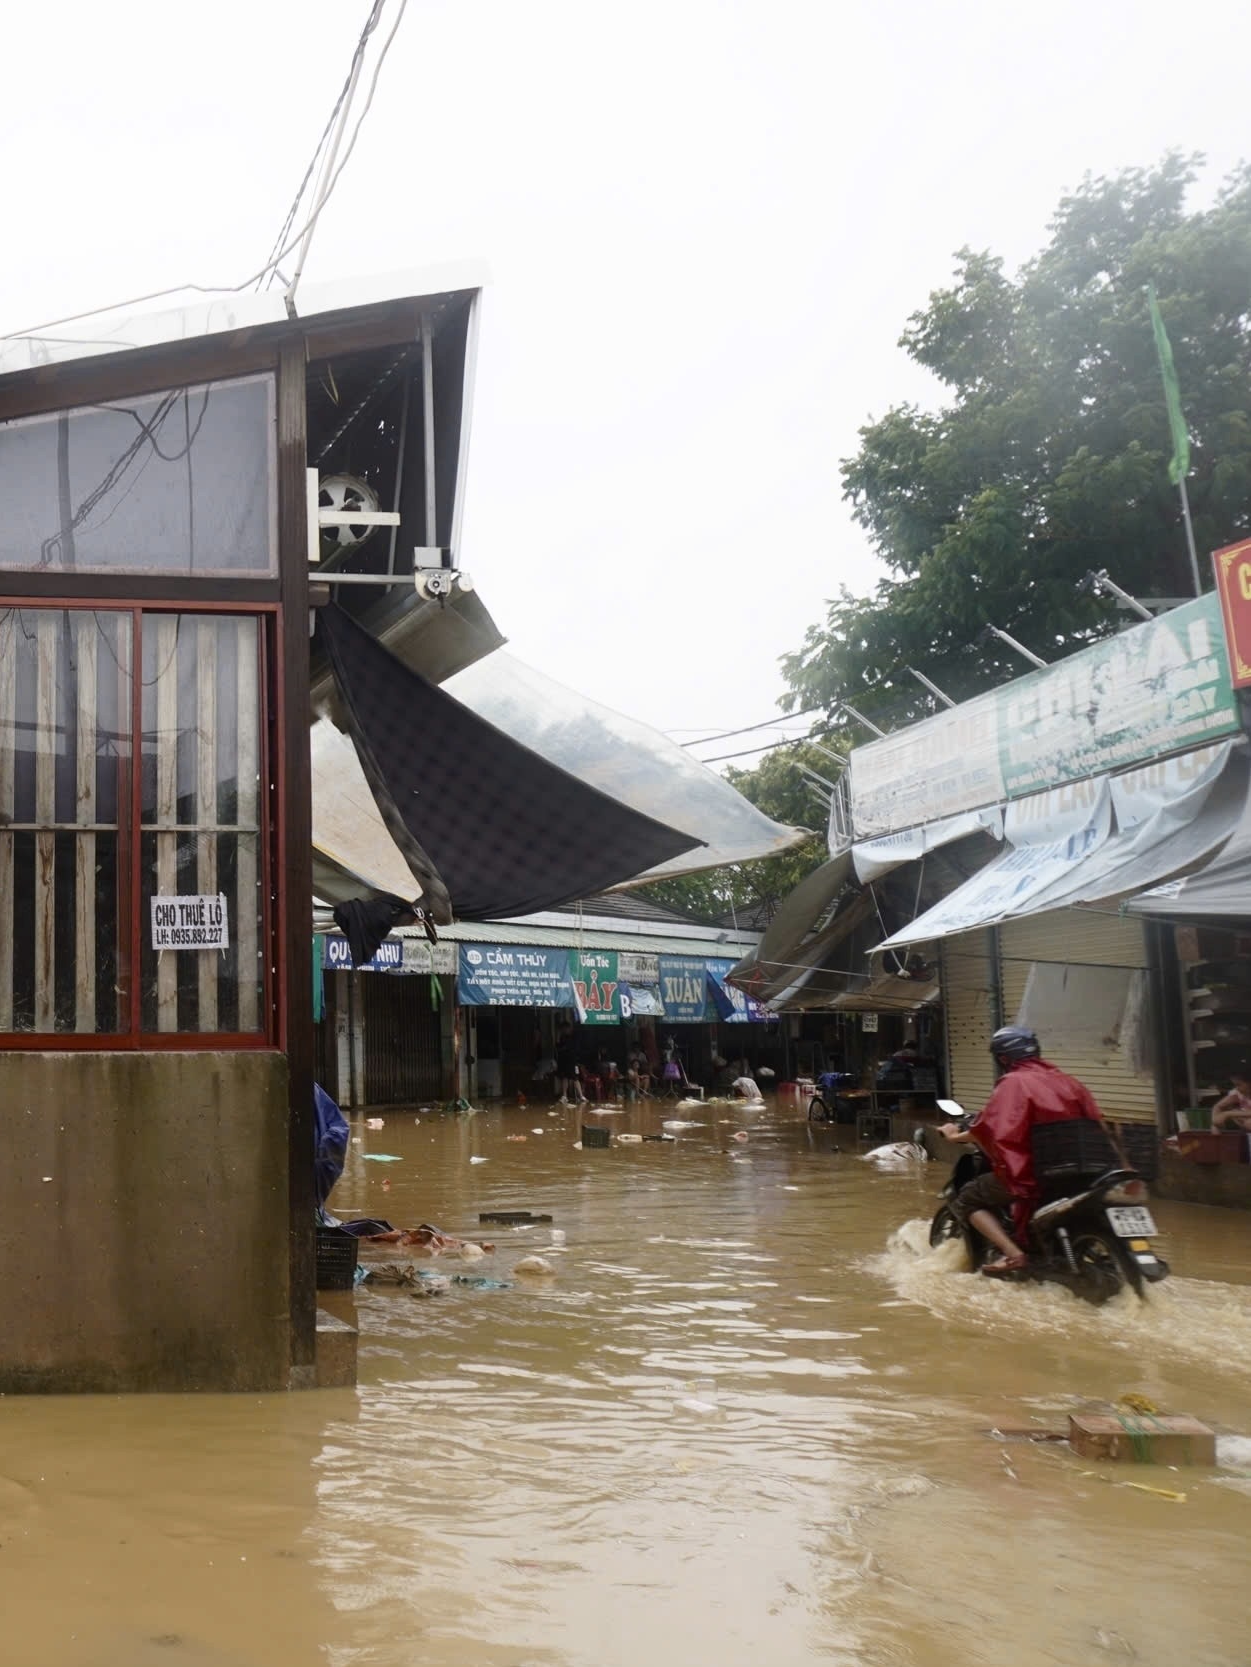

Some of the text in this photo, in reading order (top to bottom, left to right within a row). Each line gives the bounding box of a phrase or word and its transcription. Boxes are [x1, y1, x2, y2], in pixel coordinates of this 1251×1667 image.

[155, 898, 223, 927] CHO THUÊ LÔ
[156, 929, 169, 945] LH:
[663, 971, 703, 1004] XUÂN
